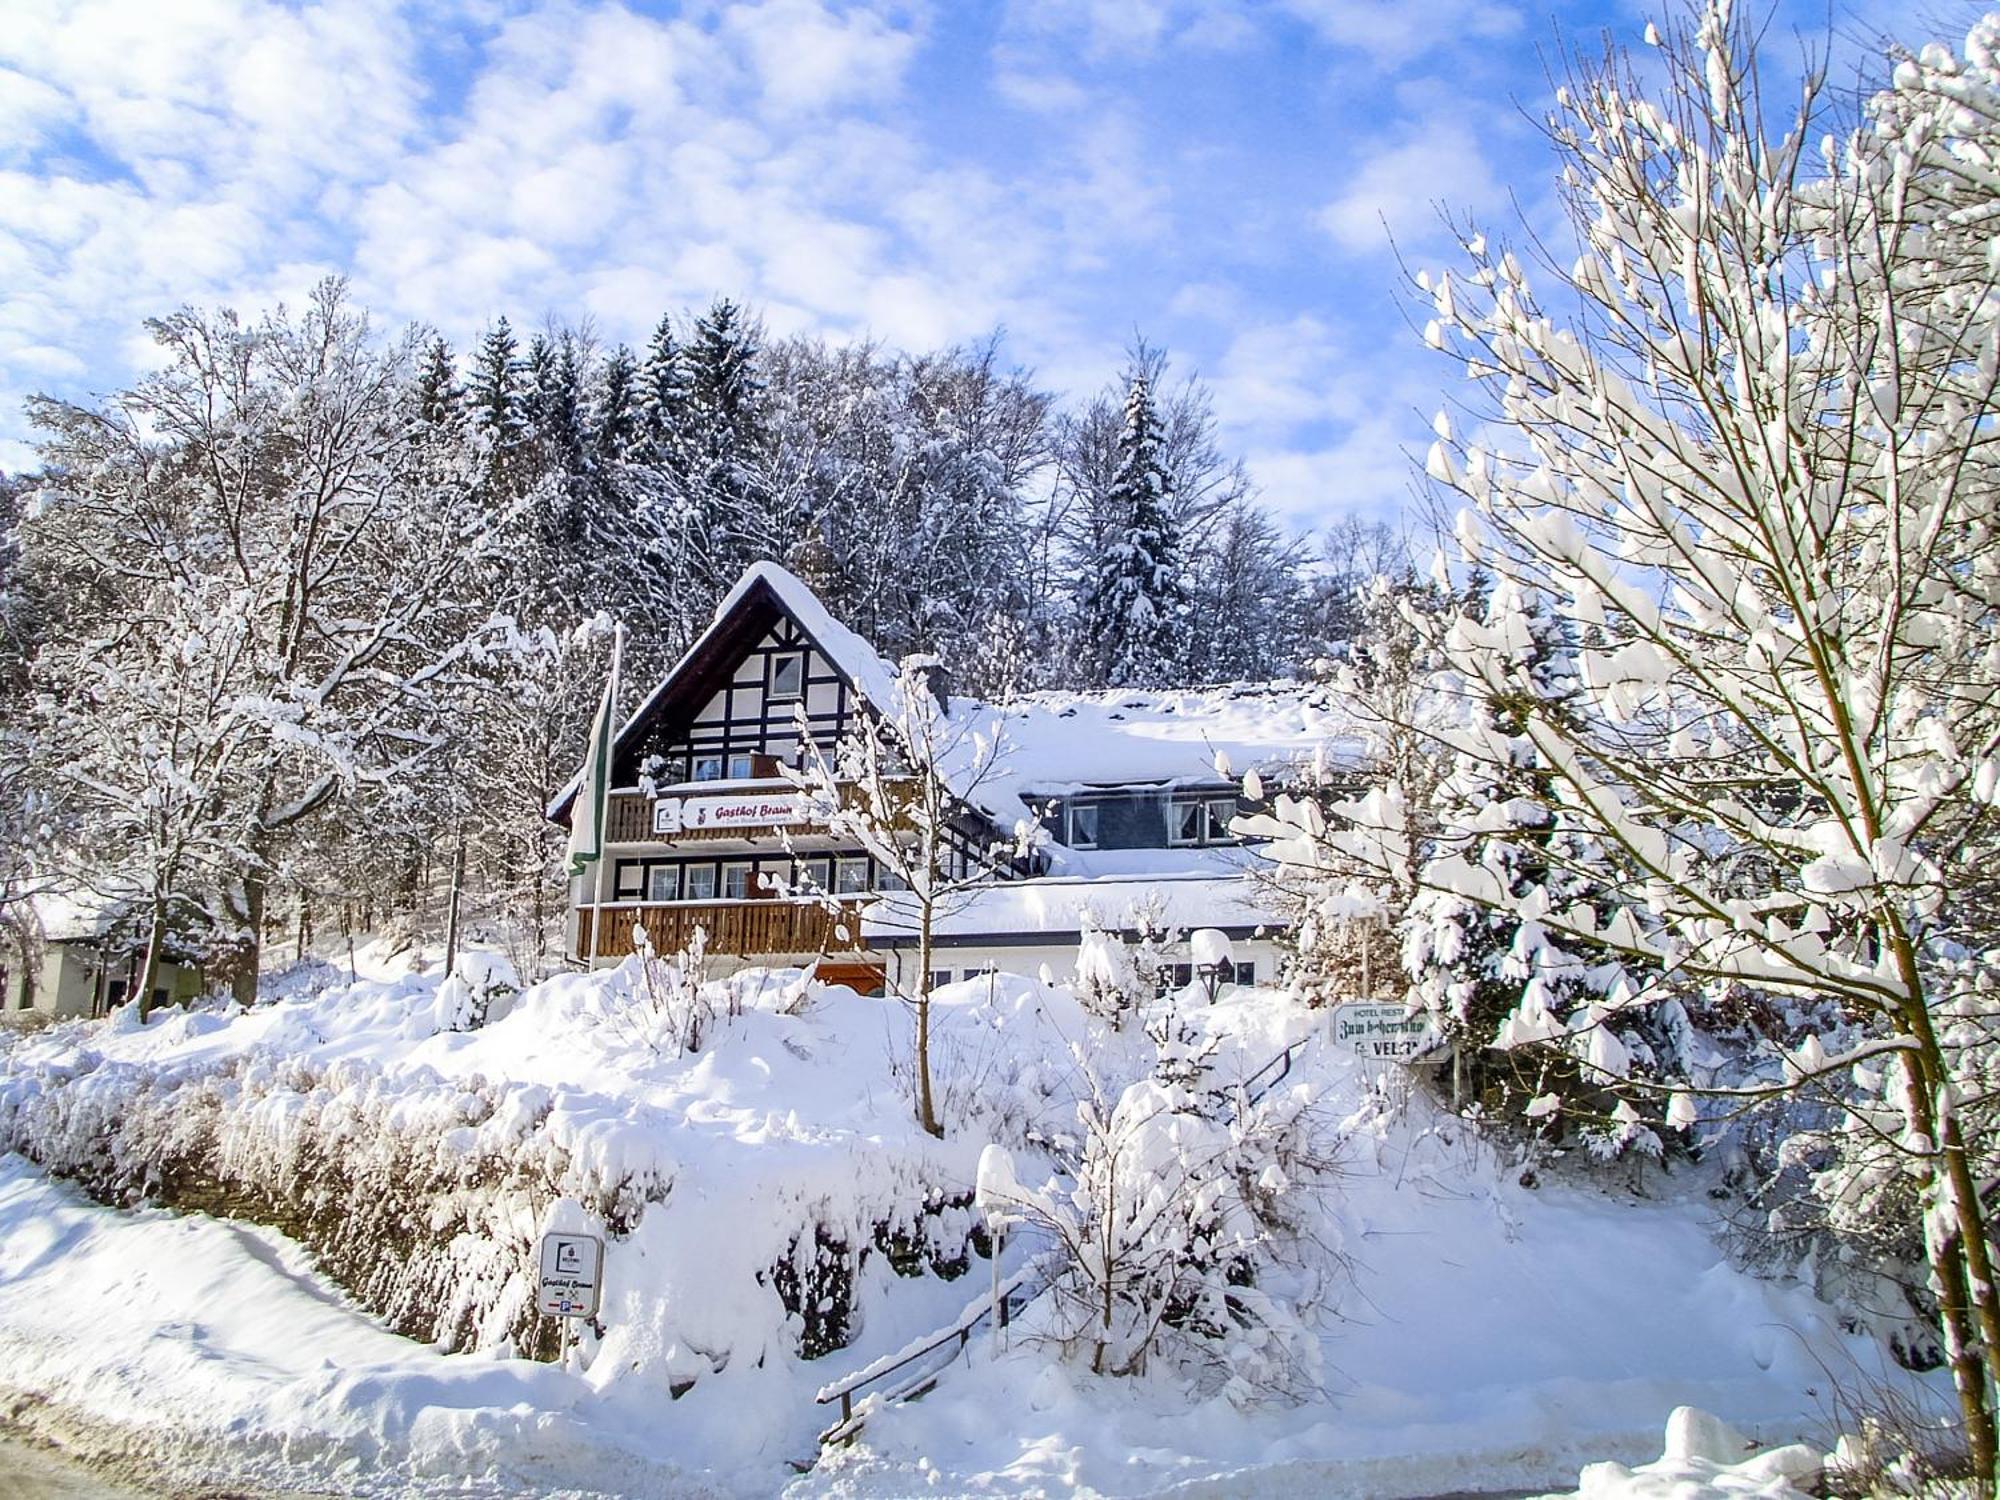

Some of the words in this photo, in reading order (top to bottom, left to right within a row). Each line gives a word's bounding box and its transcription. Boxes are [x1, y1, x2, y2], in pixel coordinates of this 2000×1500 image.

[715, 805, 757, 819] Gasthof
[1354, 1009, 1379, 1017] HOTEL
[1381, 1008, 1405, 1017] REST
